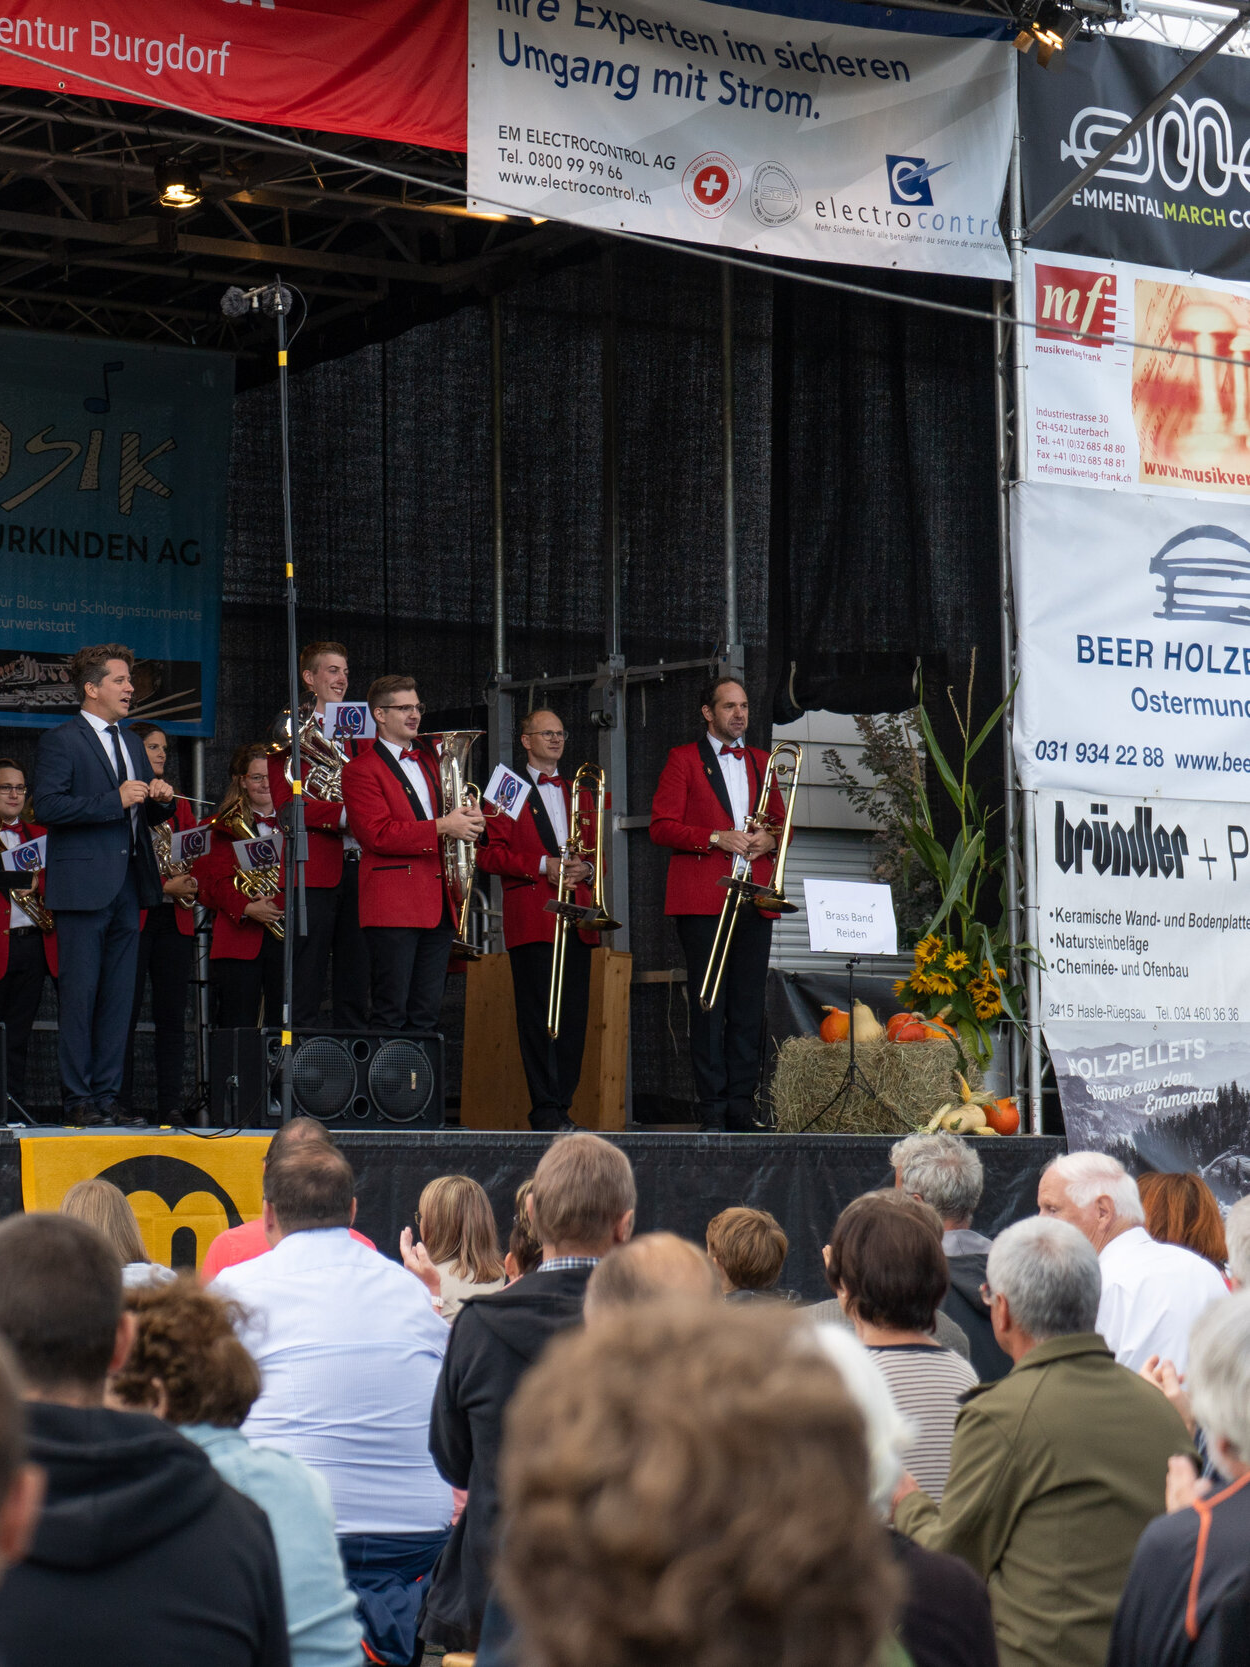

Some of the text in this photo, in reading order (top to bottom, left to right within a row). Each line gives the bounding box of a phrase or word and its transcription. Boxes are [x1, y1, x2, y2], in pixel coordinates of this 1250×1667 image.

[90, 20, 231, 76] Burgdorf
[723, 29, 766, 65] im
[775, 41, 910, 82] sicheren
[498, 28, 820, 119] Umgang mit Strom.
[499, 125, 676, 170] EM ELECTROCONTROL AG
[498, 147, 623, 180] Tel. 0800 99 99 66
[498, 171, 652, 205] www.electrocontrol.ch
[1036, 407, 1109, 423] Industriestrasse 30
[1036, 421, 1109, 438] CH-4542 Luterbach
[1036, 435, 1050, 445] Tel.
[1052, 438, 1064, 447] +41
[1086, 442, 1101, 451] 685
[1102, 443, 1113, 453] 48
[1115, 444, 1126, 454] 80
[1036, 449, 1050, 459] Fax
[1053, 452, 1067, 461] +41
[1087, 456, 1102, 465] 685
[1103, 458, 1114, 467] 48
[1115, 458, 1125, 468] 81
[157, 537, 201, 567] AG
[52, 600, 77, 613] und
[80, 600, 202, 621] Schlaginstrumente
[1076, 634, 1154, 669] BEER
[1035, 739, 1068, 762] 031
[1075, 742, 1110, 764] 934
[1115, 745, 1138, 766] 22
[1142, 746, 1165, 767] 88
[825, 910, 874, 923] Brass Band
[1055, 906, 1122, 925] Keramische
[1125, 909, 1161, 927] Wand-
[1164, 912, 1186, 928] und
[836, 927, 867, 939] Reiden
[1056, 932, 1149, 955] Natursteinbeläge
[1056, 957, 1189, 978] Cheminée- und Ofenbau
[1048, 1003, 1239, 1021] 3415 Hasle-Rüegsau Tel. 034 460 36 36
[1134, 1077, 1160, 1095] aus
[1161, 1069, 1193, 1088] dem
[1144, 1087, 1219, 1116] Emmental
